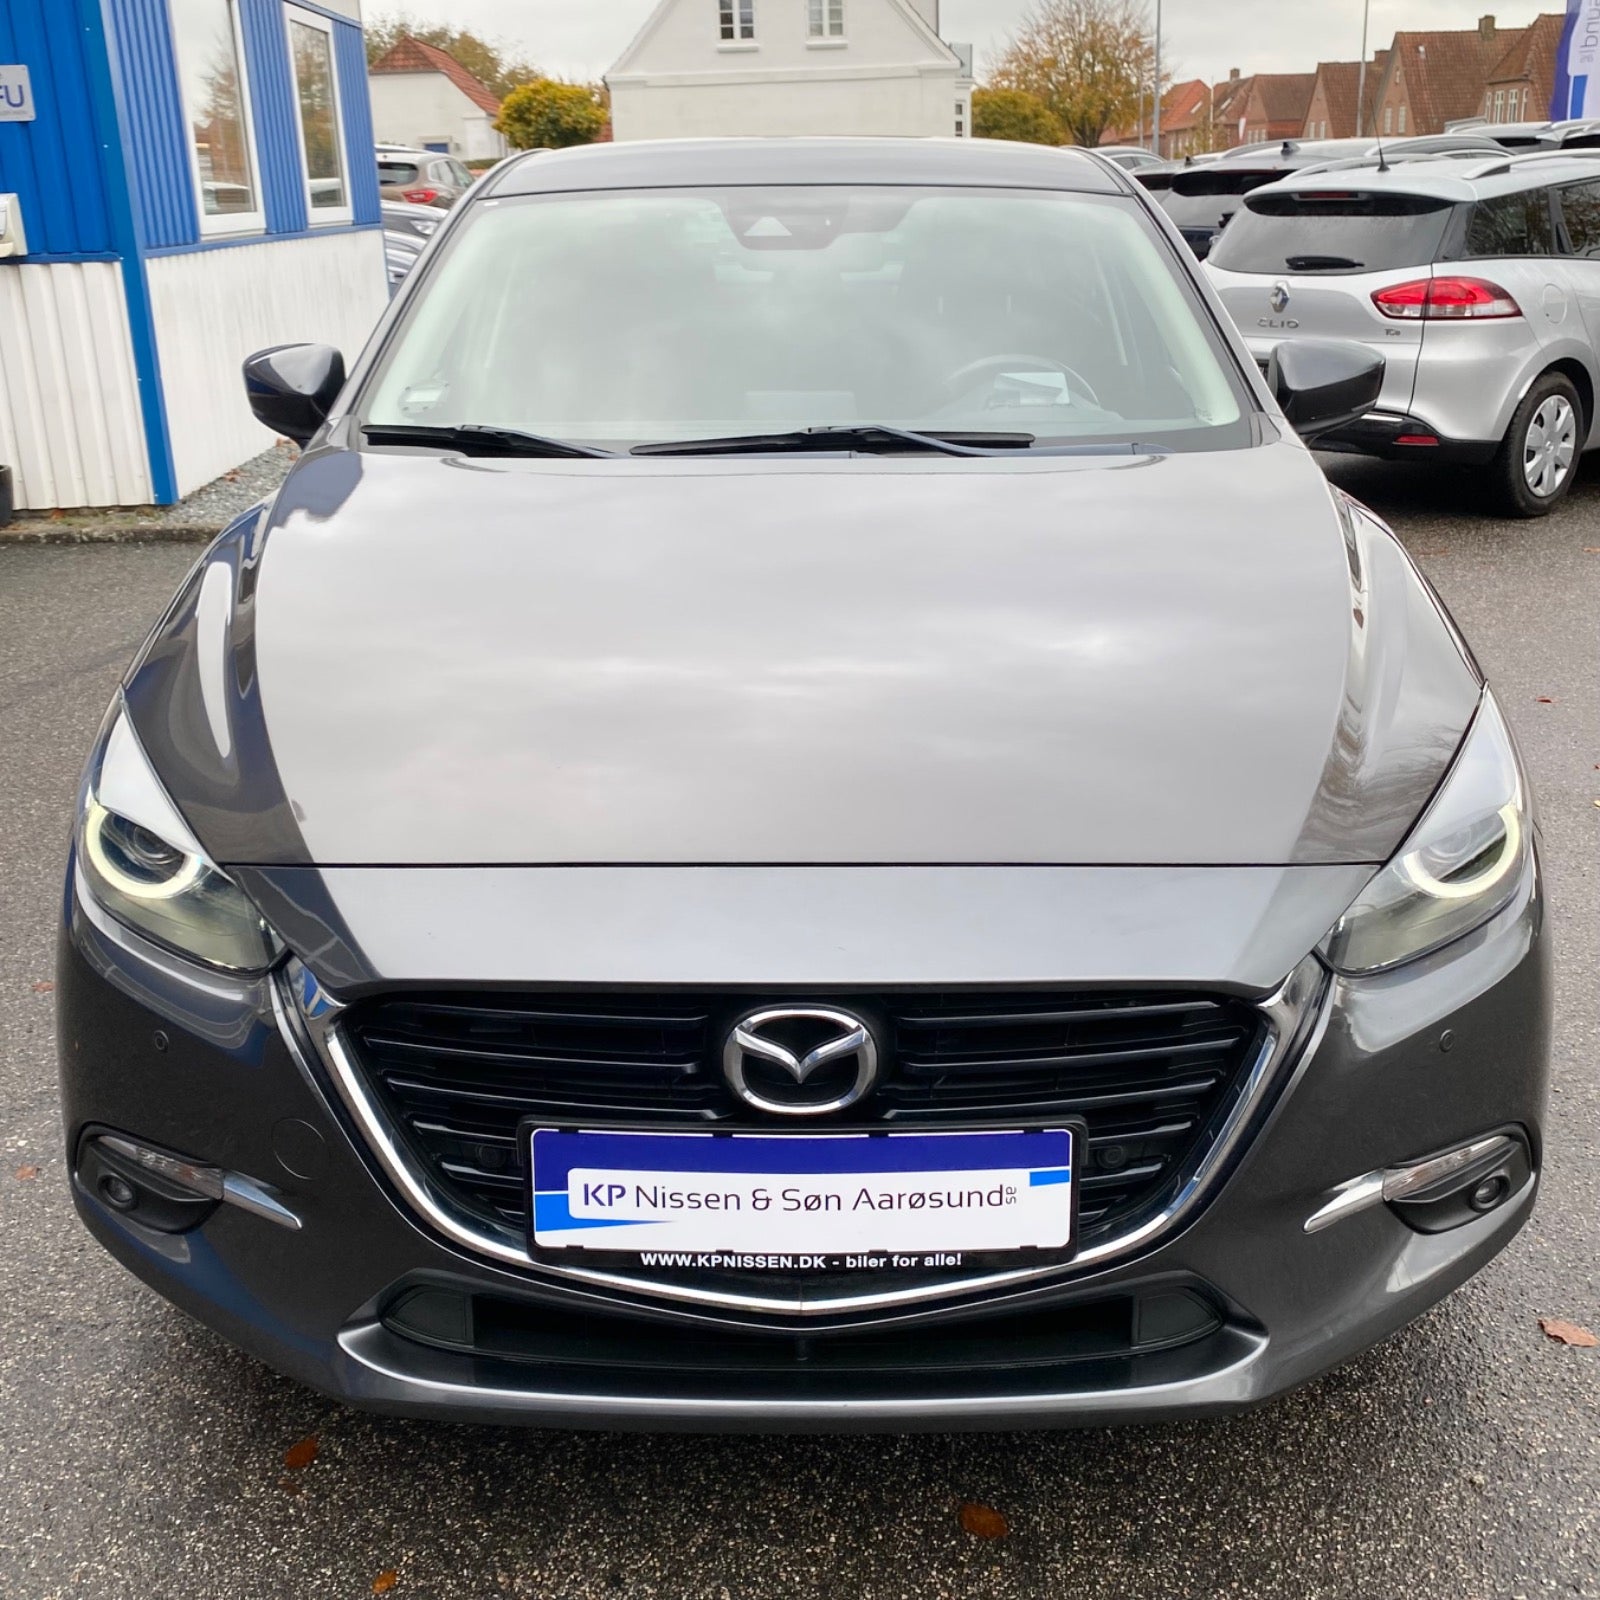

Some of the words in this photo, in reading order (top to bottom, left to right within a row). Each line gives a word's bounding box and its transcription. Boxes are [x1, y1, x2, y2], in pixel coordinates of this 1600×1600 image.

[1257, 317, 1299, 329] CLIO
[584, 1183, 626, 1207] KP
[636, 1185, 741, 1210] Nissen
[752, 1188, 773, 1211] &
[781, 1189, 842, 1211] Søn
[853, 1184, 1003, 1211] Aarøsund
[640, 1252, 826, 1269] WWW.KPNISSEN.DK
[846, 1255, 886, 1269] biler
[892, 1254, 918, 1268] for
[924, 1253, 962, 1267] alle!
